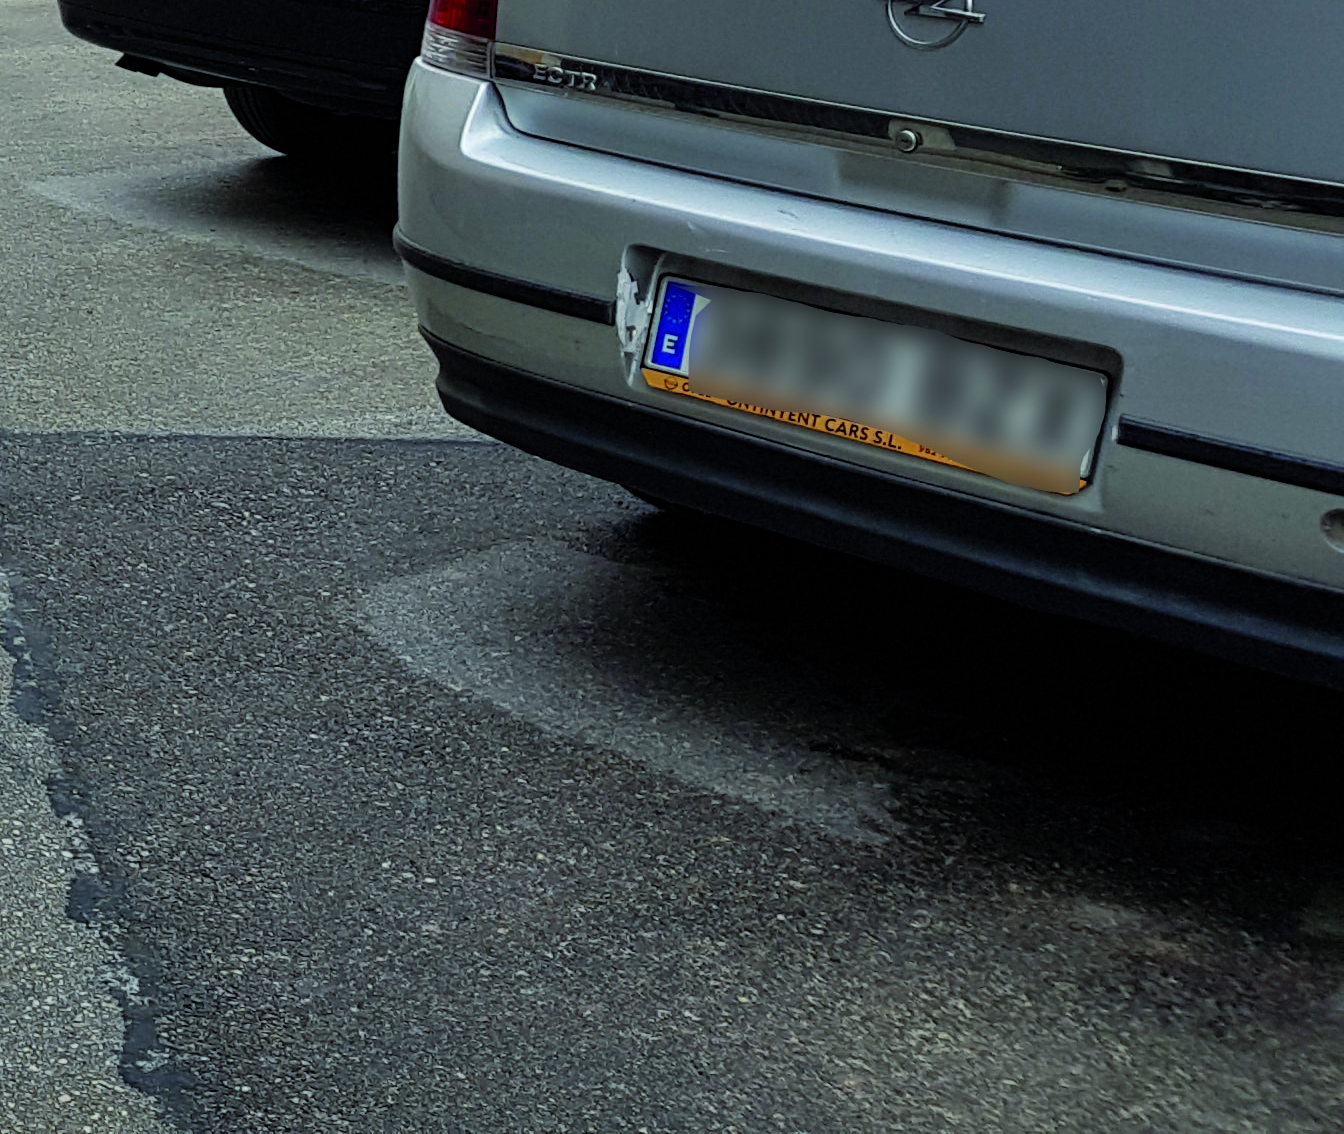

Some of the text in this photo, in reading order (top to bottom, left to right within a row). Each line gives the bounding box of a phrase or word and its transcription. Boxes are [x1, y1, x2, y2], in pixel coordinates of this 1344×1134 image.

[662, 333, 679, 355] E
[824, 418, 869, 441] CARS
[873, 430, 903, 451] S.L.
